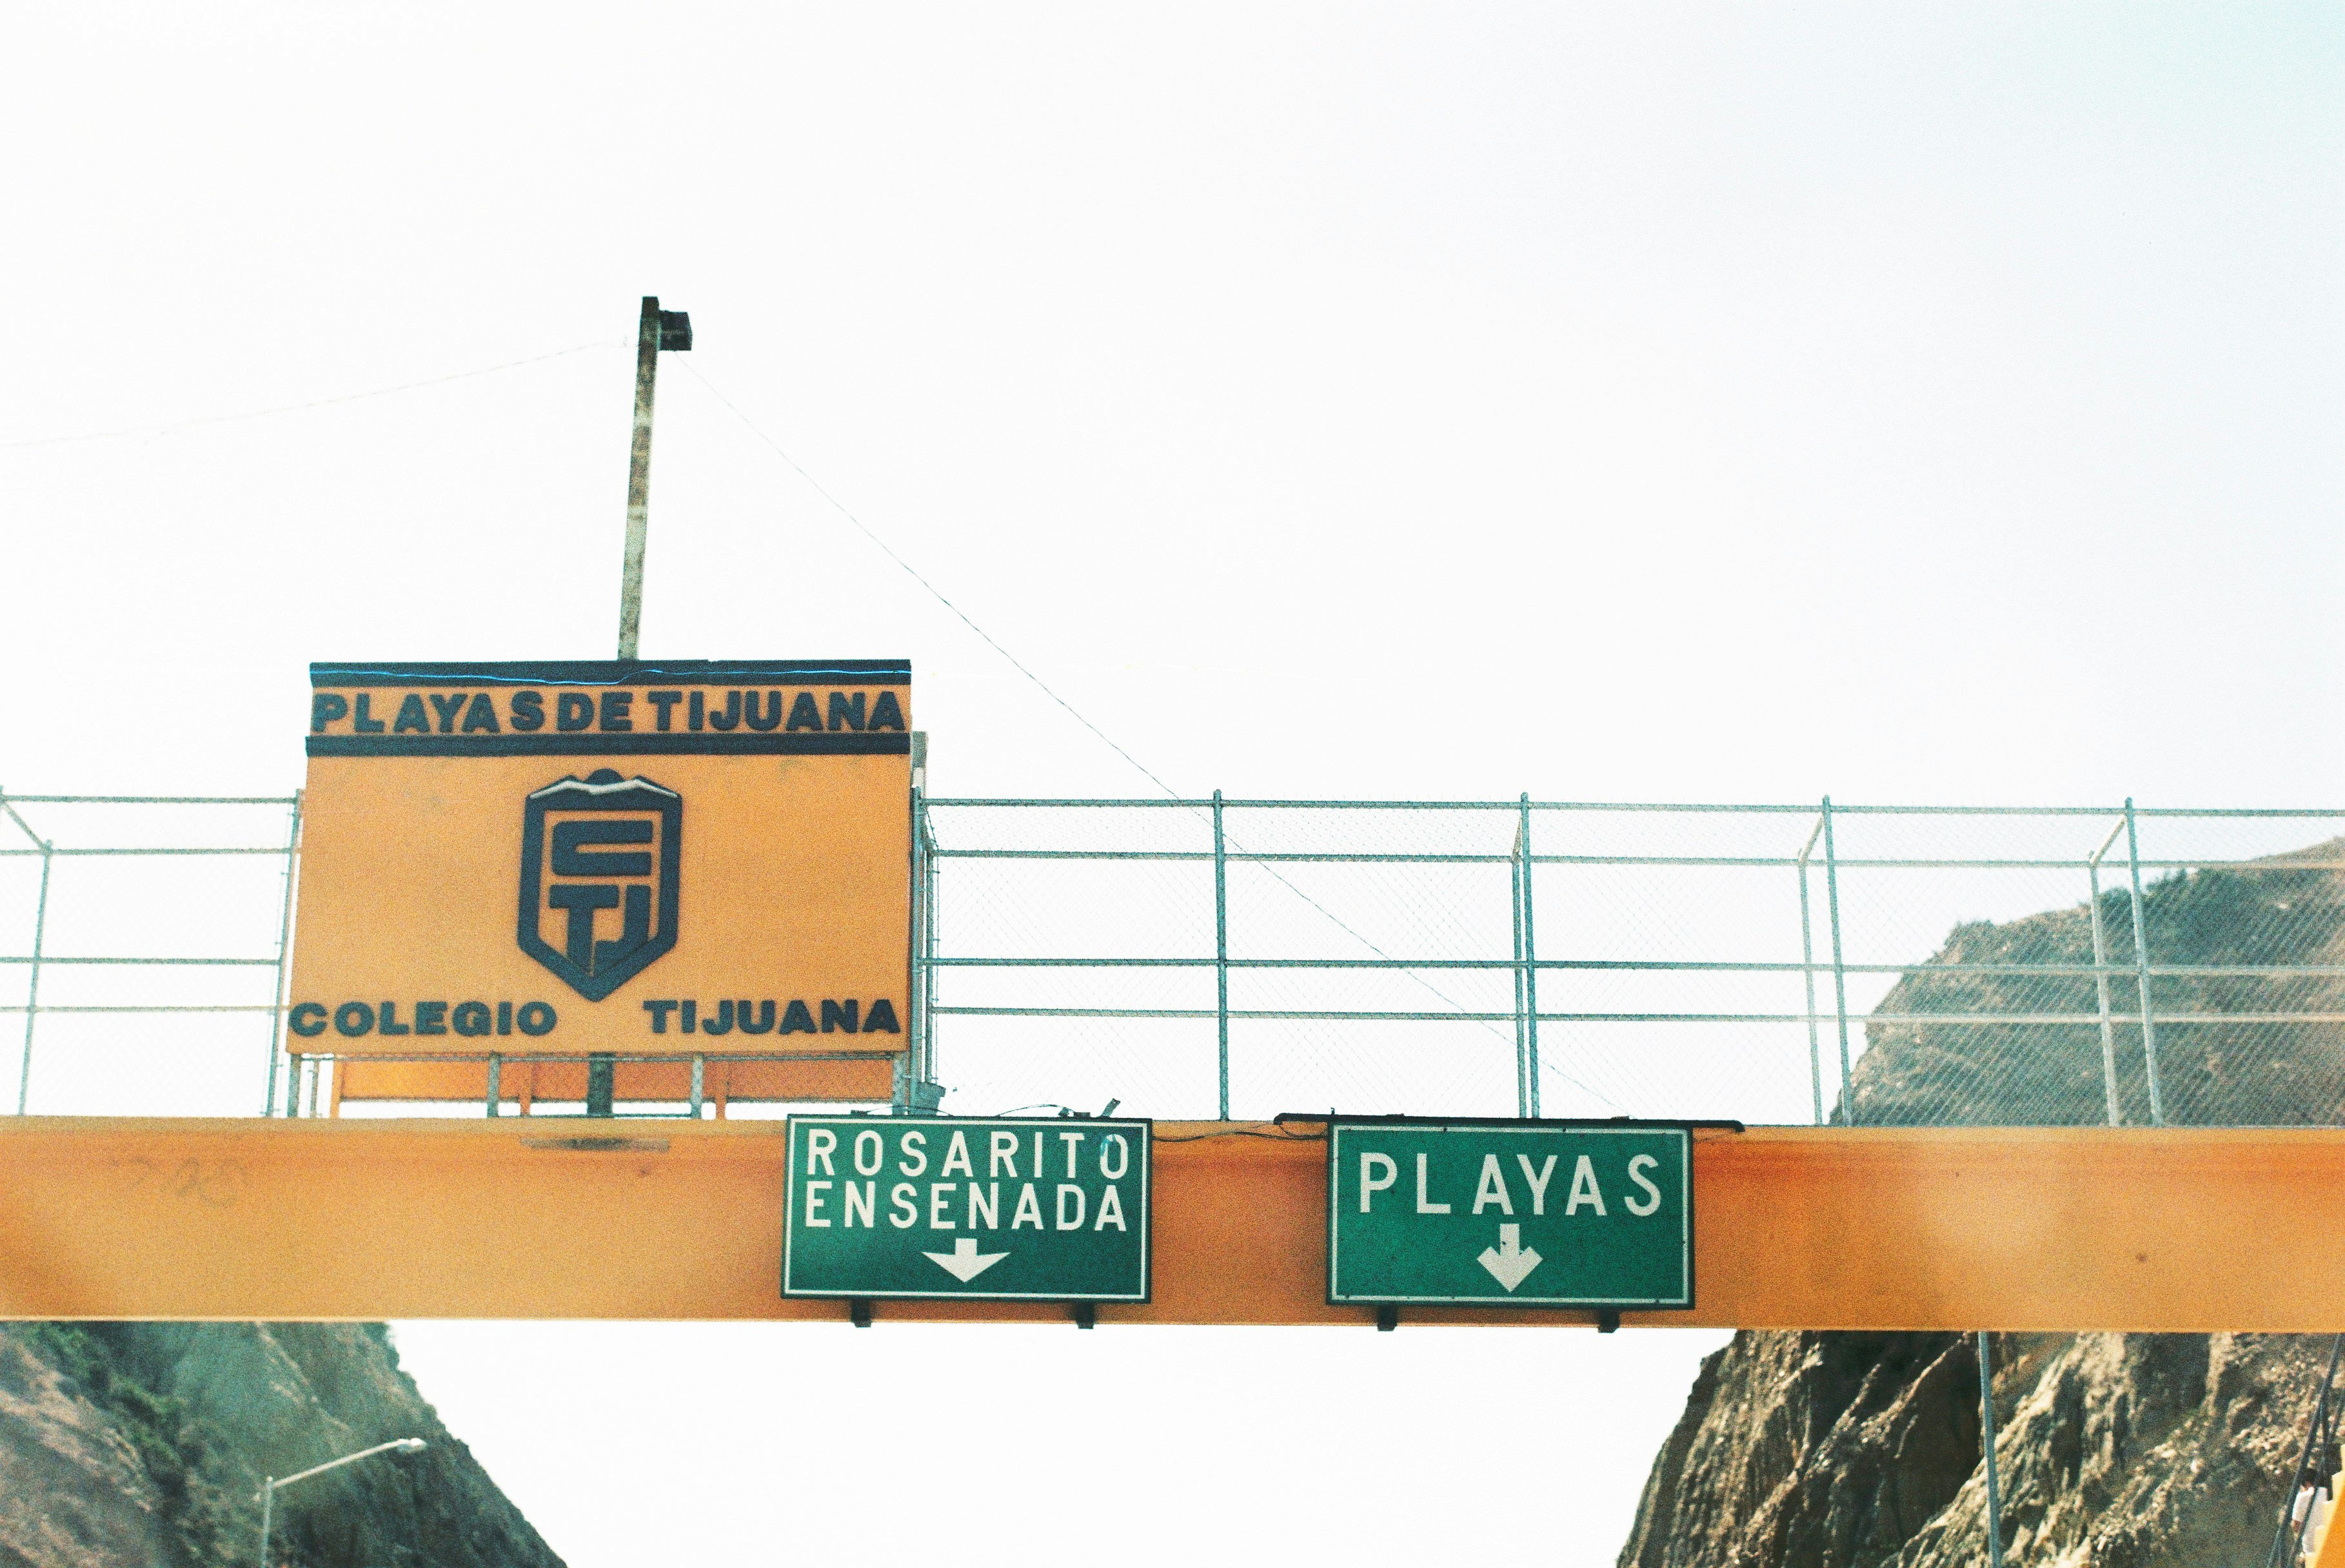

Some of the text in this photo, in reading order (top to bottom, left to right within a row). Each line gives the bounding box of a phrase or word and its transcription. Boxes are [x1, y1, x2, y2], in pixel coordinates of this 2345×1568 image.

[312, 691, 906, 734] PLAYAS DE TIJUANA
[288, 999, 901, 1037] COLEGIO TIJUANA
[806, 1128, 1129, 1179] ROSARITO
[804, 1181, 1127, 1232] ENSENADA
[1360, 1152, 1661, 1217] PLAYAS
